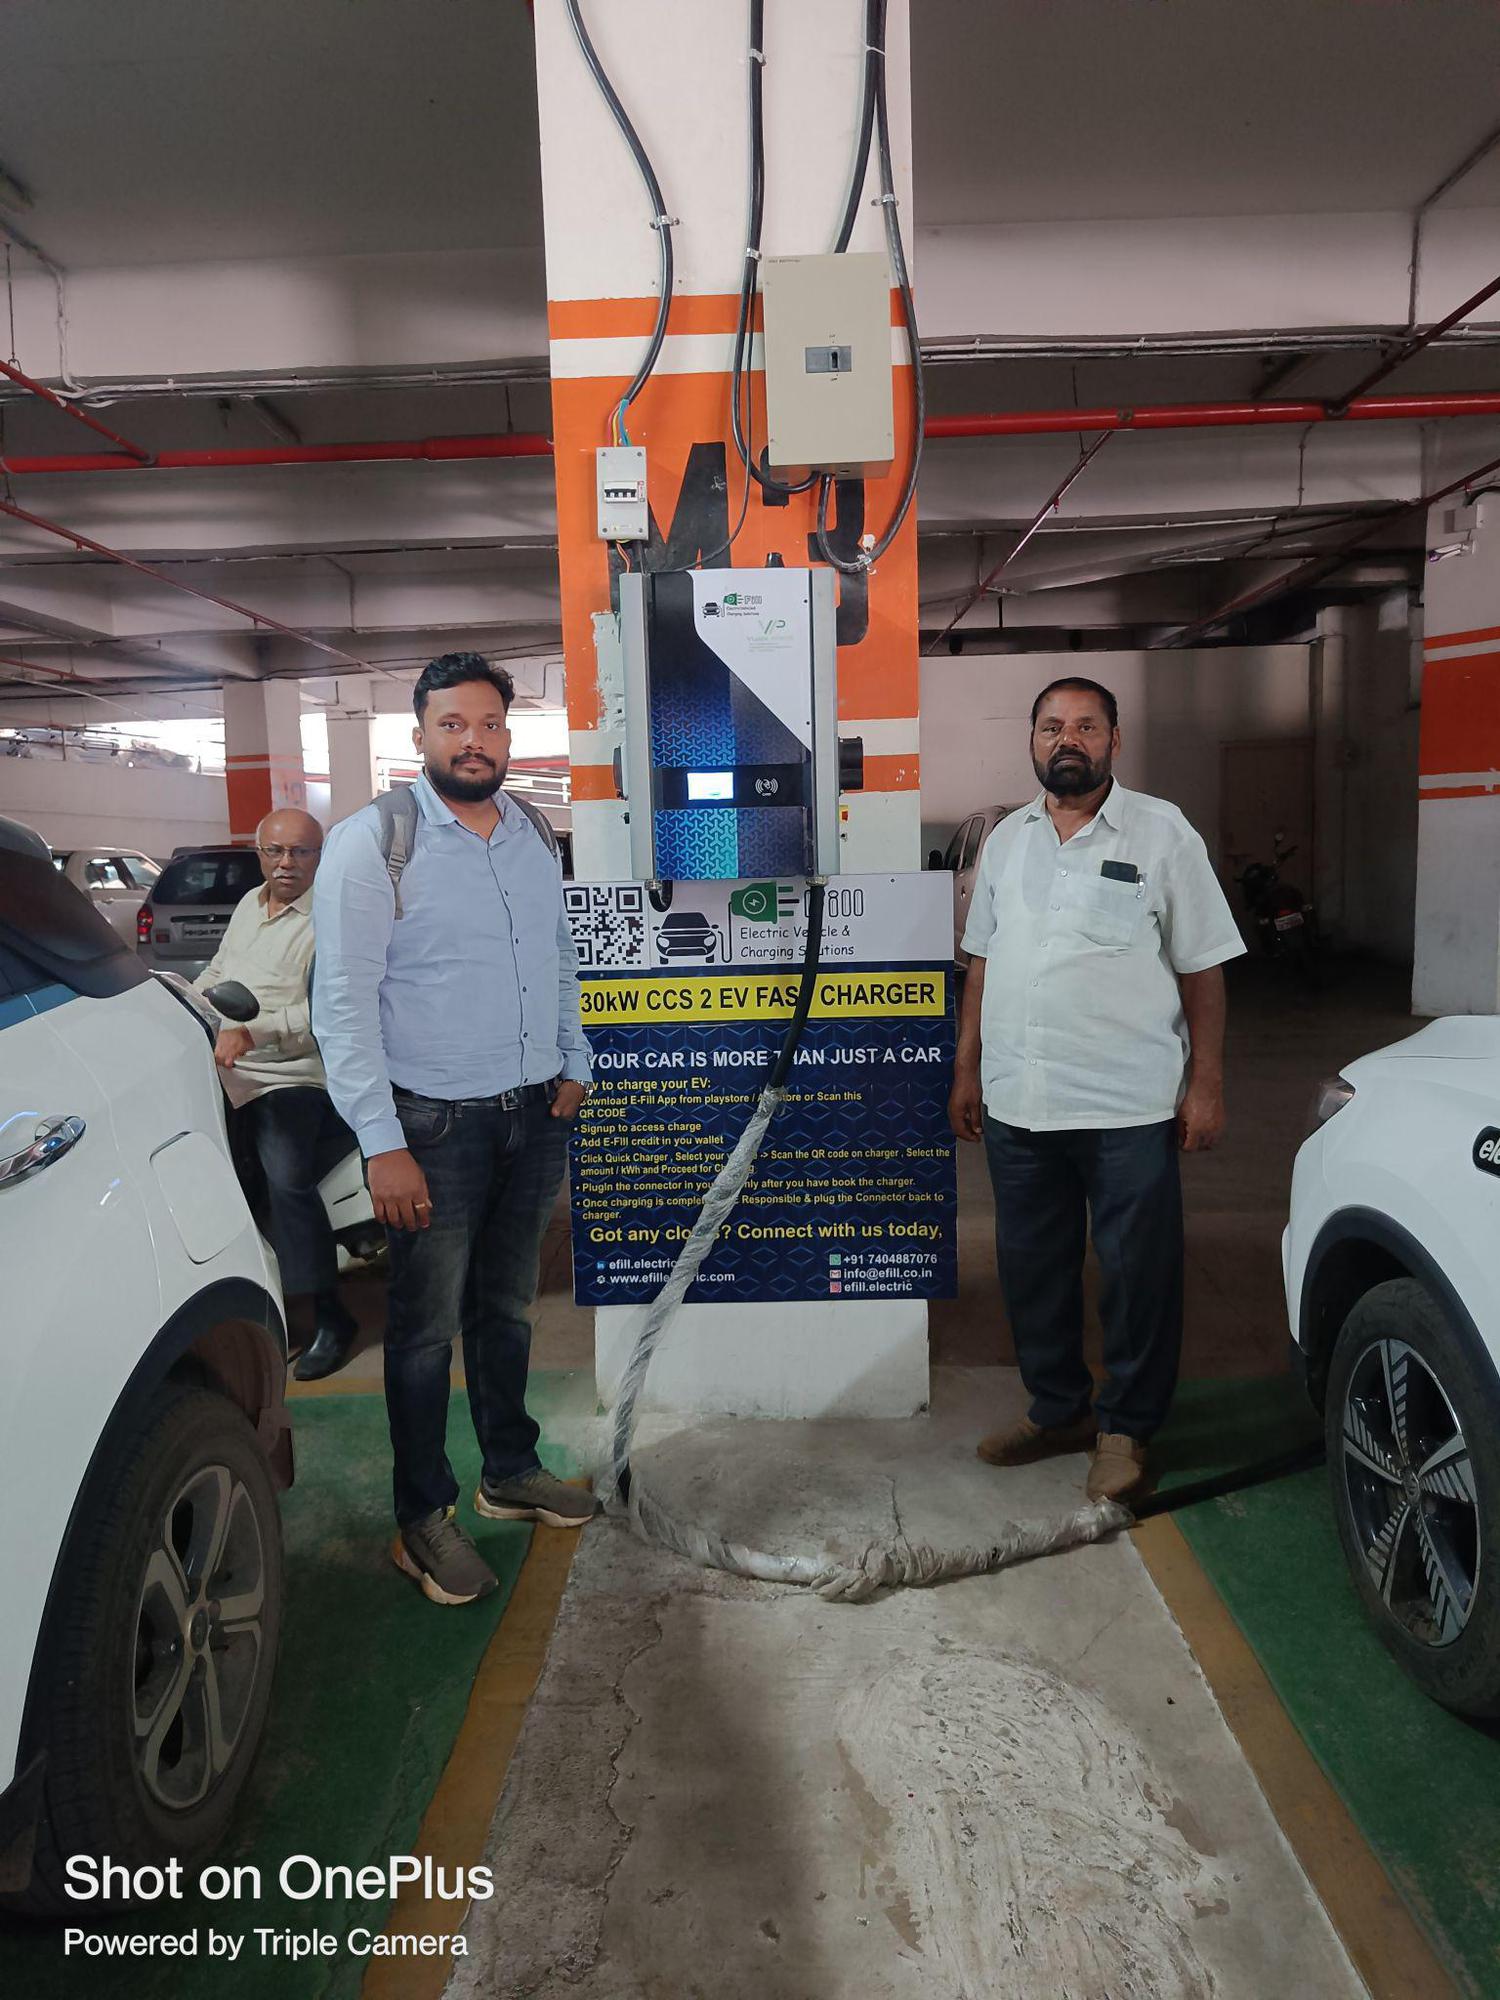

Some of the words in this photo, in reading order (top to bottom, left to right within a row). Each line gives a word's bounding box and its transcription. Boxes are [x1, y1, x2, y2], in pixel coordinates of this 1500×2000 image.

[740, 926, 789, 940] Electric
[793, 924, 838, 938] Vecle
[841, 924, 851, 937] &
[740, 946, 794, 960] Charging
[798, 944, 855, 956] Sutions
[580, 990, 640, 1013] 30kW
[646, 988, 694, 1011] CCS
[700, 988, 712, 1009] 2
[719, 987, 749, 1009] EV
[756, 984, 800, 1008] FAS
[820, 983, 936, 1006] CHARGER
[588, 1052, 640, 1070] YOUR
[645, 1052, 685, 1069] CAR
[690, 1051, 708, 1068] IS
[713, 1050, 768, 1067] MORE
[830, 1048, 878, 1065] JUST
[882, 1047, 897, 1064] A
[901, 1047, 942, 1063] CAR
[601, 1079, 614, 1091] to
[616, 1078, 658, 1092] charge
[661, 1080, 689, 1092] your
[691, 1077, 711, 1089] EV:
[630, 1095, 655, 1105] E-Fill
[657, 1095, 677, 1107] App
[679, 1094, 702, 1104] from
[704, 1094, 750, 1106] playstore
[817, 1091, 841, 1101] Scan
[843, 1091, 862, 1100] this
[579, 1108, 595, 1119] QR
[597, 1107, 627, 1118] CODE
[580, 1124, 616, 1135] Signup
[618, 1124, 628, 1133] to
[630, 1123, 665, 1132] access
[667, 1121, 702, 1133] charge
[580, 1139, 601, 1148] Add
[603, 1137, 629, 1147] E-Fill
[631, 1136, 660, 1146] credit
[662, 1136, 671, 1145] in
[674, 1136, 692, 1147] you
[695, 1134, 724, 1145] wallet
[580, 1154, 603, 1164] Click
[605, 1154, 631, 1164] Quick
[633, 1153, 668, 1165] Charger
[675, 1151, 702, 1162] Select
[704, 1152, 725, 1163] your
[771, 1150, 793, 1160] Scan
[795, 1149, 810, 1159] the
[811, 1148, 826, 1160] QR
[827, 1148, 849, 1159] code
[851, 1150, 863, 1158] on
[865, 1147, 899, 1160] charger
[906, 1147, 932, 1158] Select
[934, 1147, 950, 1157] the
[580, 1166, 614, 1177] amount
[621, 1165, 641, 1175] kWh
[643, 1164, 659, 1174] and
[661, 1163, 698, 1174] Proceed
[699, 1163, 712, 1173] for
[615, 1181, 631, 1192] the
[633, 1180, 682, 1190] connector
[684, 1180, 694, 1190] in
[744, 1179, 759, 1191] nly
[761, 1178, 783, 1188] after
[786, 1179, 804, 1189] you
[806, 1177, 830, 1188] have
[832, 1176, 856, 1187] book
[858, 1177, 874, 1187] the
[876, 1176, 916, 1189] charger.
[582, 1198, 608, 1208] Once
[610, 1197, 653, 1209] charging
[655, 1196, 664, 1206] is
[666, 1196, 705, 1207] complet
[741, 1193, 801, 1205] Responsible
[803, 1193, 812, 1203] &
[814, 1193, 835, 1205] plug
[837, 1192, 853, 1202] the
[855, 1191, 906, 1202] Connector
[908, 1190, 931, 1201] back
[933, 1191, 944, 1201] to
[582, 1210, 622, 1222] charger.
[590, 1226, 623, 1243] Got
[628, 1229, 660, 1244] any
[737, 1224, 813, 1240] Connect
[818, 1221, 856, 1238] with
[861, 1224, 883, 1237] us
[888, 1221, 943, 1240] today,
[609, 1257, 677, 1270] efill.electric
[844, 1254, 864, 1265] +91
[868, 1253, 938, 1265] 7404887076
[843, 1267, 933, 1281] info@efill.co.in
[844, 1281, 913, 1292] efill.electric
